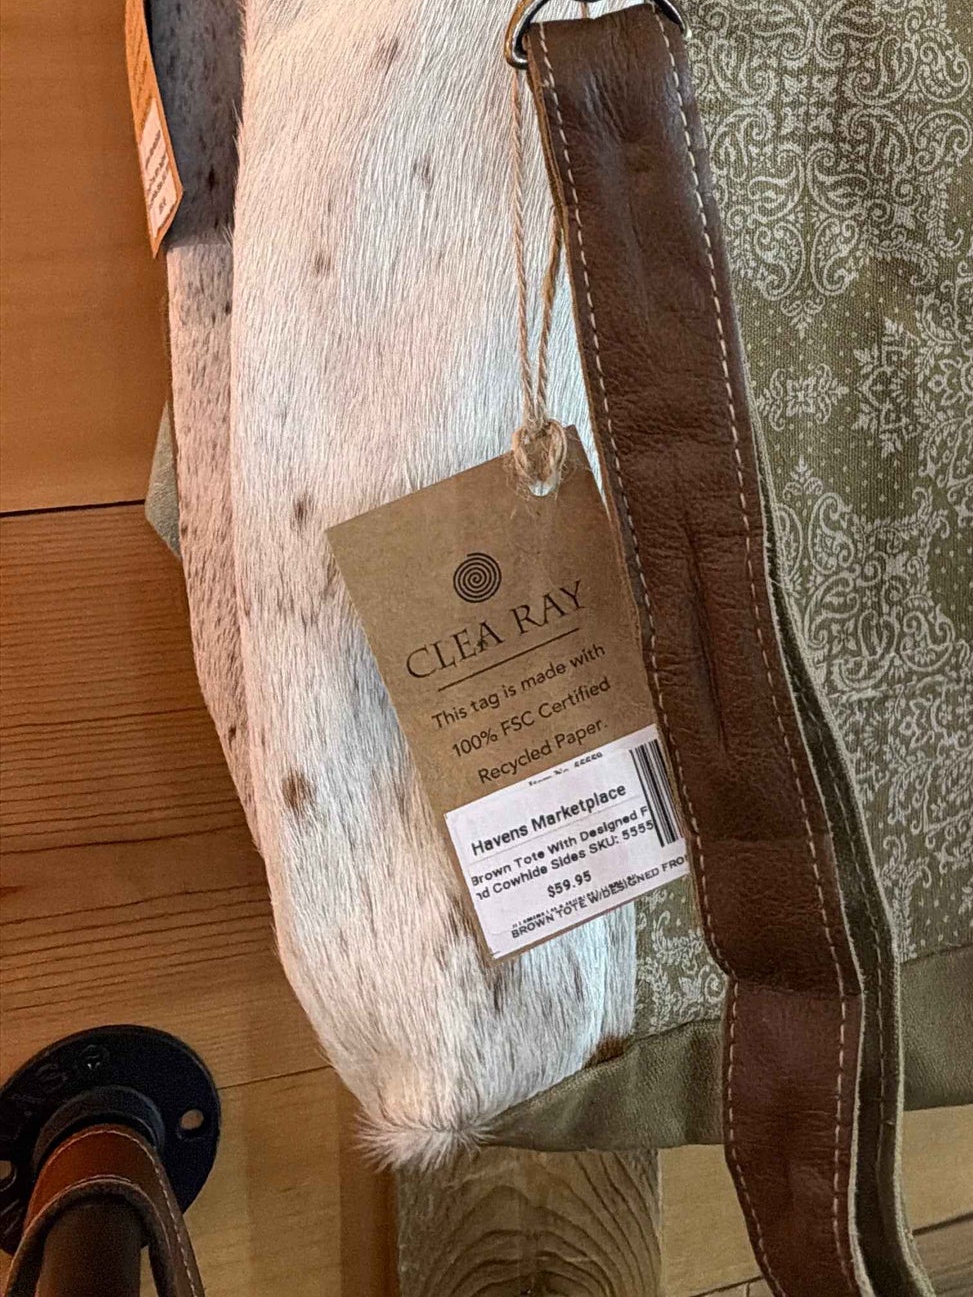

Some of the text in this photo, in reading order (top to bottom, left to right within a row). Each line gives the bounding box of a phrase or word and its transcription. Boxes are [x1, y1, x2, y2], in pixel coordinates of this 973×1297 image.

[406, 580, 585, 679] CLEA RAY
[432, 643, 606, 730] This tag is made with
[452, 677, 611, 758] 100% FSC Certified
[477, 737, 553, 784] Recycled
[554, 718, 608, 749] Paper.
[471, 783, 627, 856] Havens Marketplace
[471, 864, 512, 886] Brown
[513, 850, 545, 868] Tote
[547, 836, 577, 856] With
[579, 809, 638, 842] Designed
[492, 865, 548, 893] Cowhide
[551, 849, 587, 870] Sides
[588, 834, 619, 854] SKU:
[511, 913, 555, 939] BROWN
[555, 896, 587, 918] TOTE
[661, 853, 689, 872] FRO
[547, 869, 592, 899] $59.95
